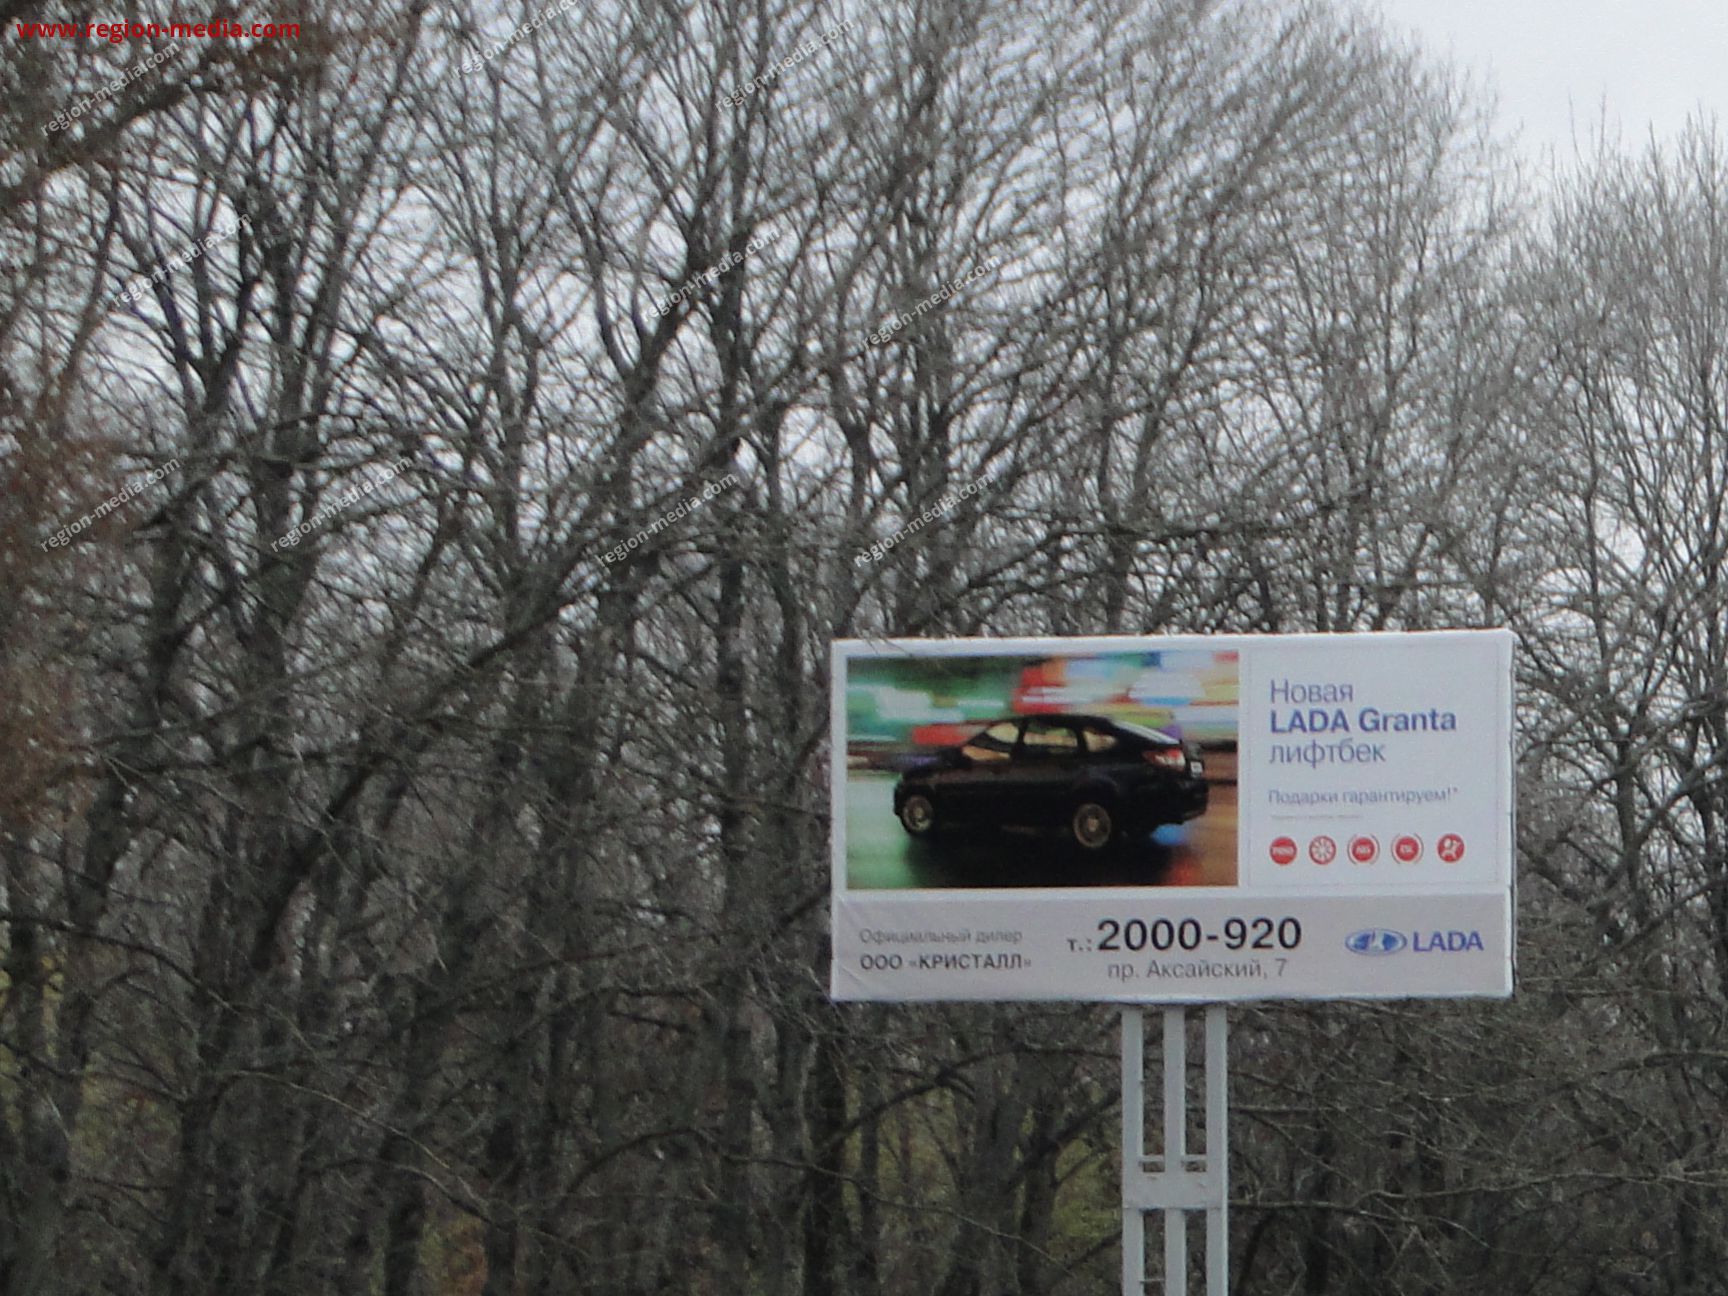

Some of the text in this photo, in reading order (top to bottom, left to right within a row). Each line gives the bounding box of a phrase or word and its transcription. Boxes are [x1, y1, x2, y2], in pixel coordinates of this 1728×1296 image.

[1270, 679, 1353, 703] Новая
[1270, 708, 1457, 733] LADA Granta
[1269, 738, 1386, 769] лифтбек
[1268, 789, 1338, 805] Подарки
[859, 928, 1023, 945] Официальный дилер
[1413, 931, 1484, 951] LADA
[860, 954, 1031, 970] ООО «КРИСТАЛЛ»
[1108, 958, 1288, 981] пр. Аксайский, 7
